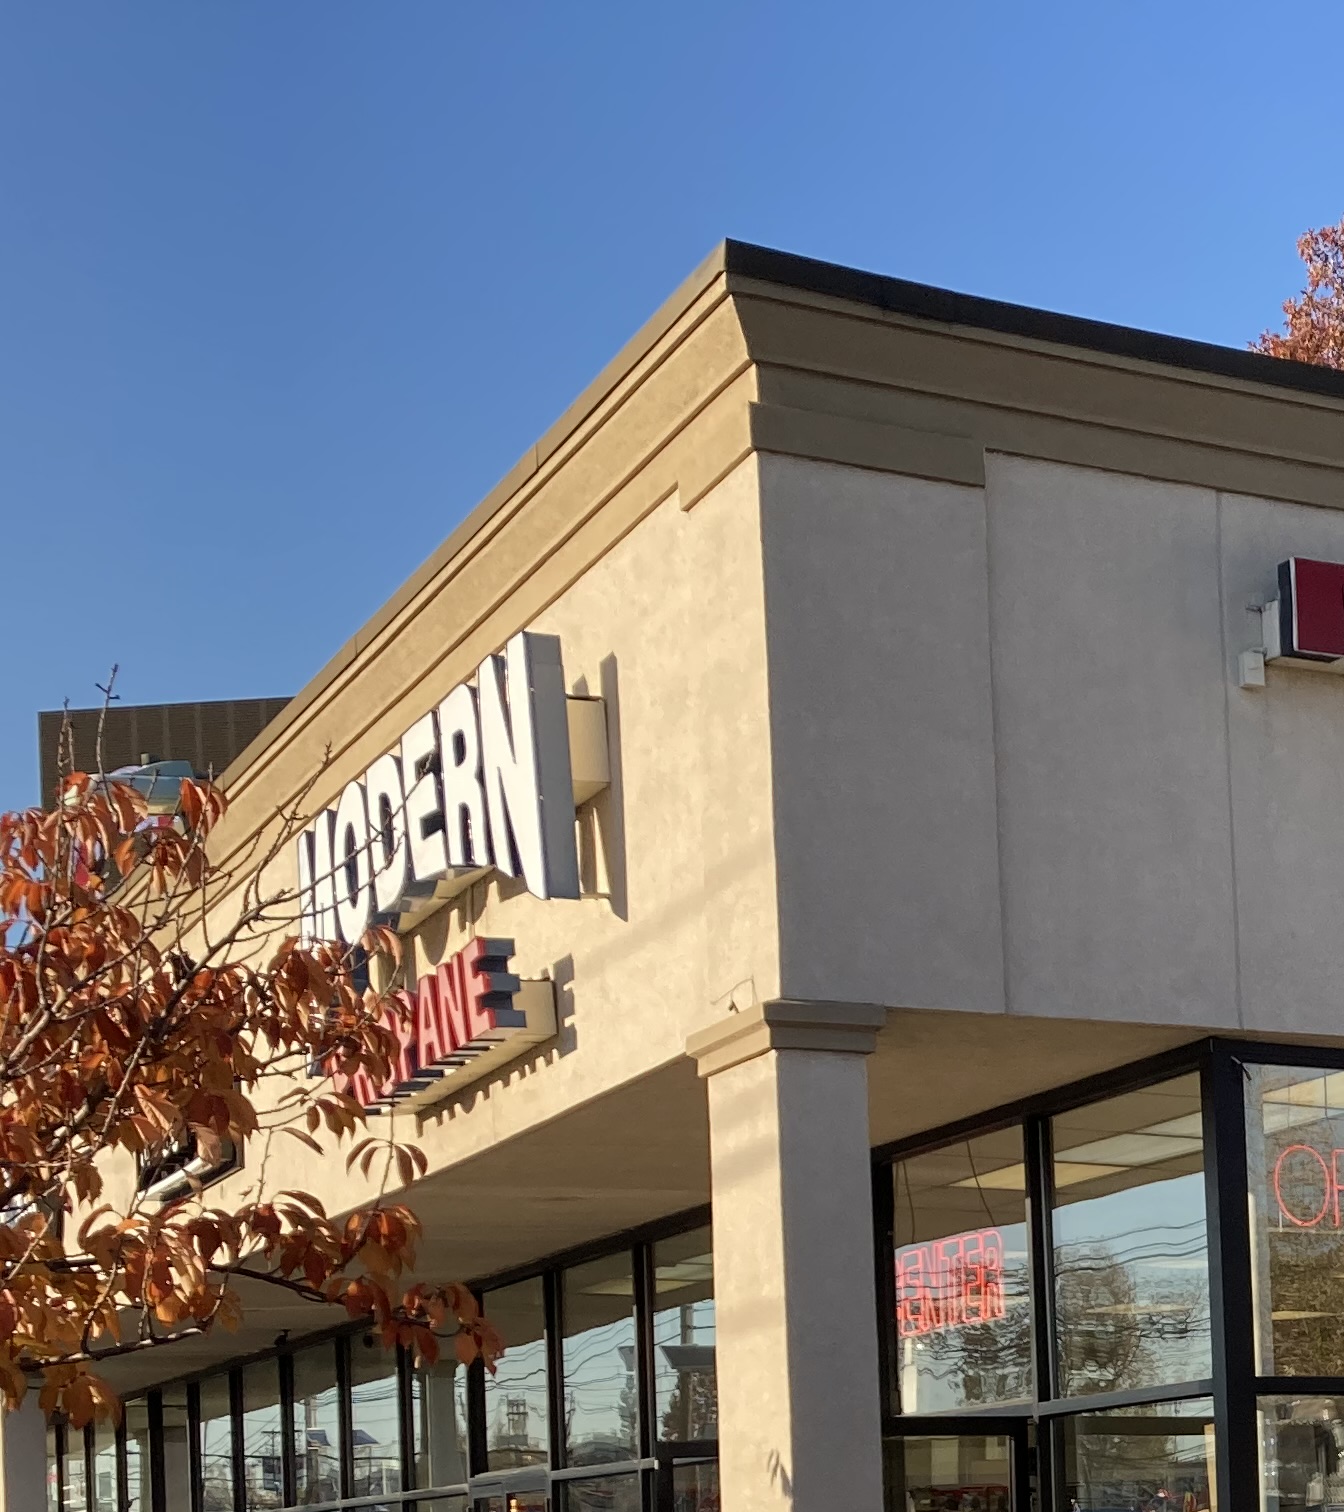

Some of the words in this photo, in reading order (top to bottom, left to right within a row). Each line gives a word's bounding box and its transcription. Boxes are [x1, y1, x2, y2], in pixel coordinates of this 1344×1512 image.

[298, 630, 552, 950] MODERN
[325, 935, 502, 1108] PANE
[895, 1229, 1005, 1336] ENTER
